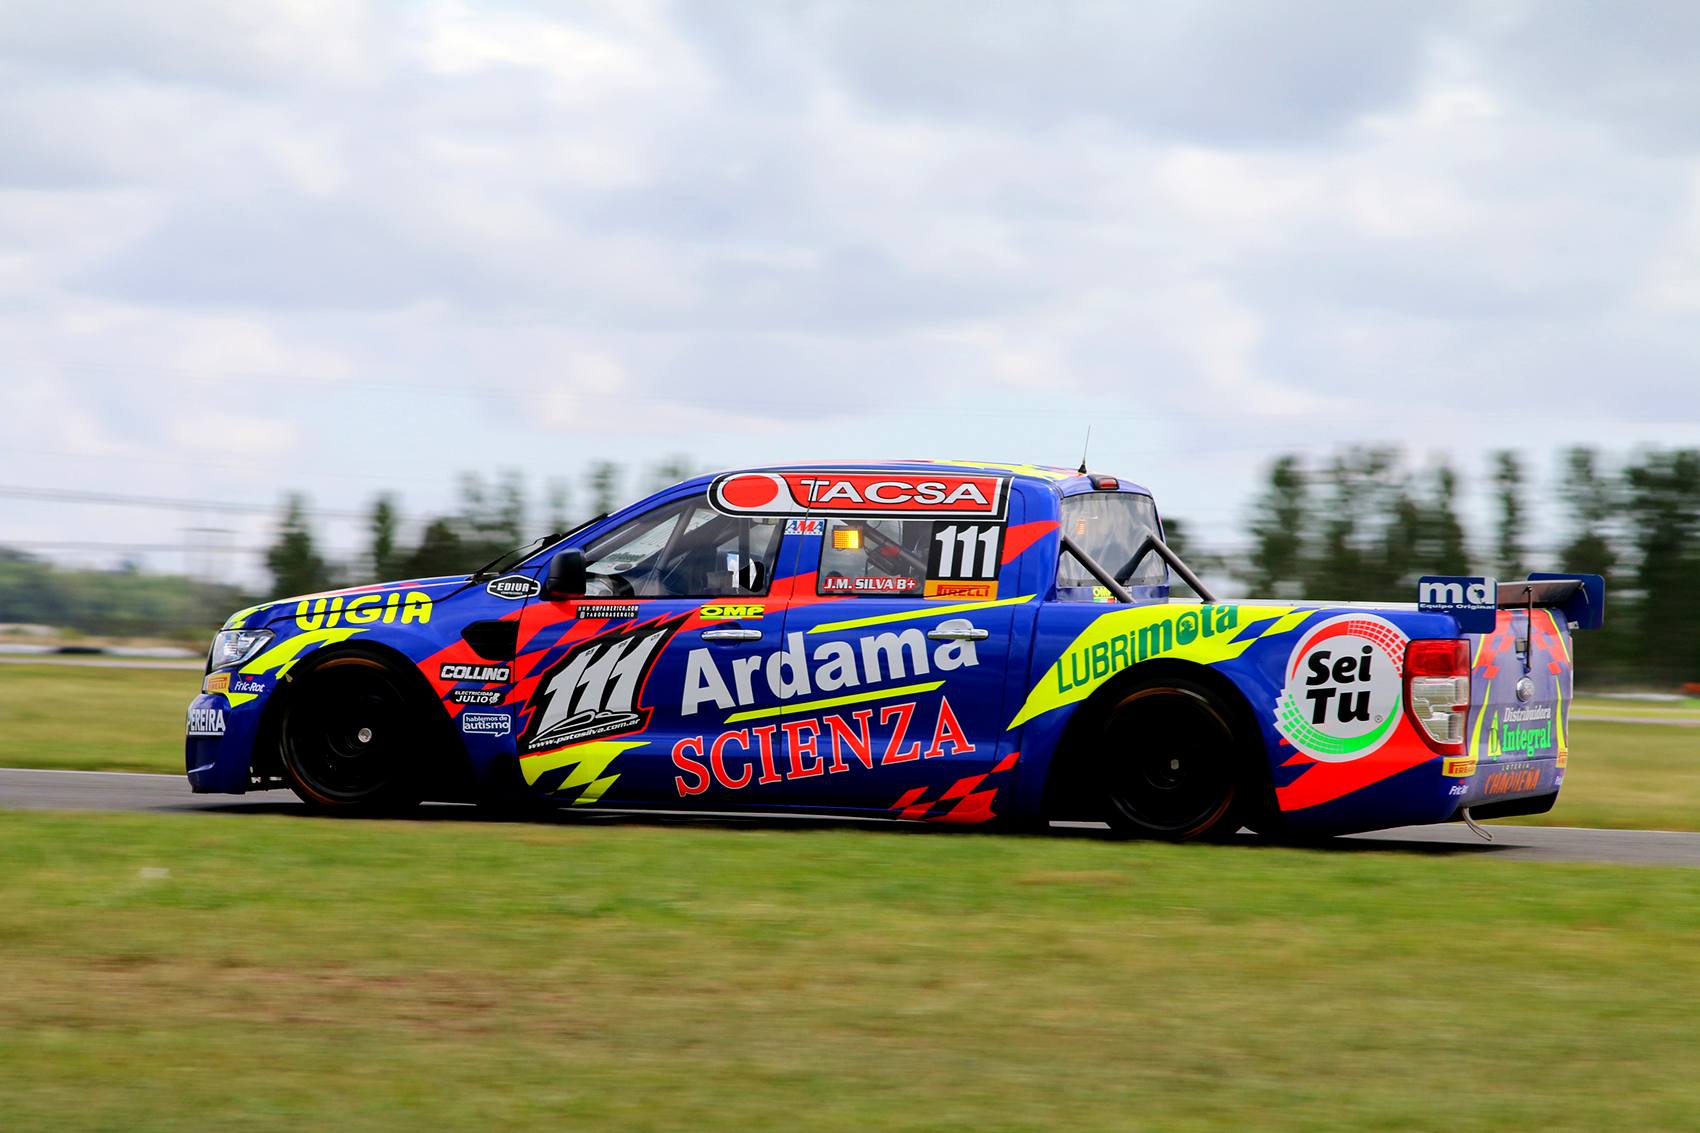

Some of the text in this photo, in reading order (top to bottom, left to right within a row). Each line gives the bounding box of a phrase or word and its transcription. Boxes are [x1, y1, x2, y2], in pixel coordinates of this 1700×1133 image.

[801, 479, 989, 505] TACSA
[936, 525, 1000, 577] 111
[824, 578, 916, 589] J.M. SILVA B+
[937, 584, 990, 597] PIRELLI
[1420, 576, 1495, 604] md
[700, 606, 765, 617] OMP
[440, 665, 510, 681] COLLINO
[681, 618, 979, 716] Ardama
[1306, 645, 1373, 686] Sei
[234, 681, 265, 692] Fric-Rot
[536, 628, 668, 735] 111
[455, 695, 488, 703] JULIO
[1306, 687, 1371, 725] Tu
[464, 721, 509, 730] autismo
[528, 719, 641, 750] www.patosilva.com.ar
[1502, 719, 1552, 757] Integral
[671, 695, 976, 797] SCIENZA
